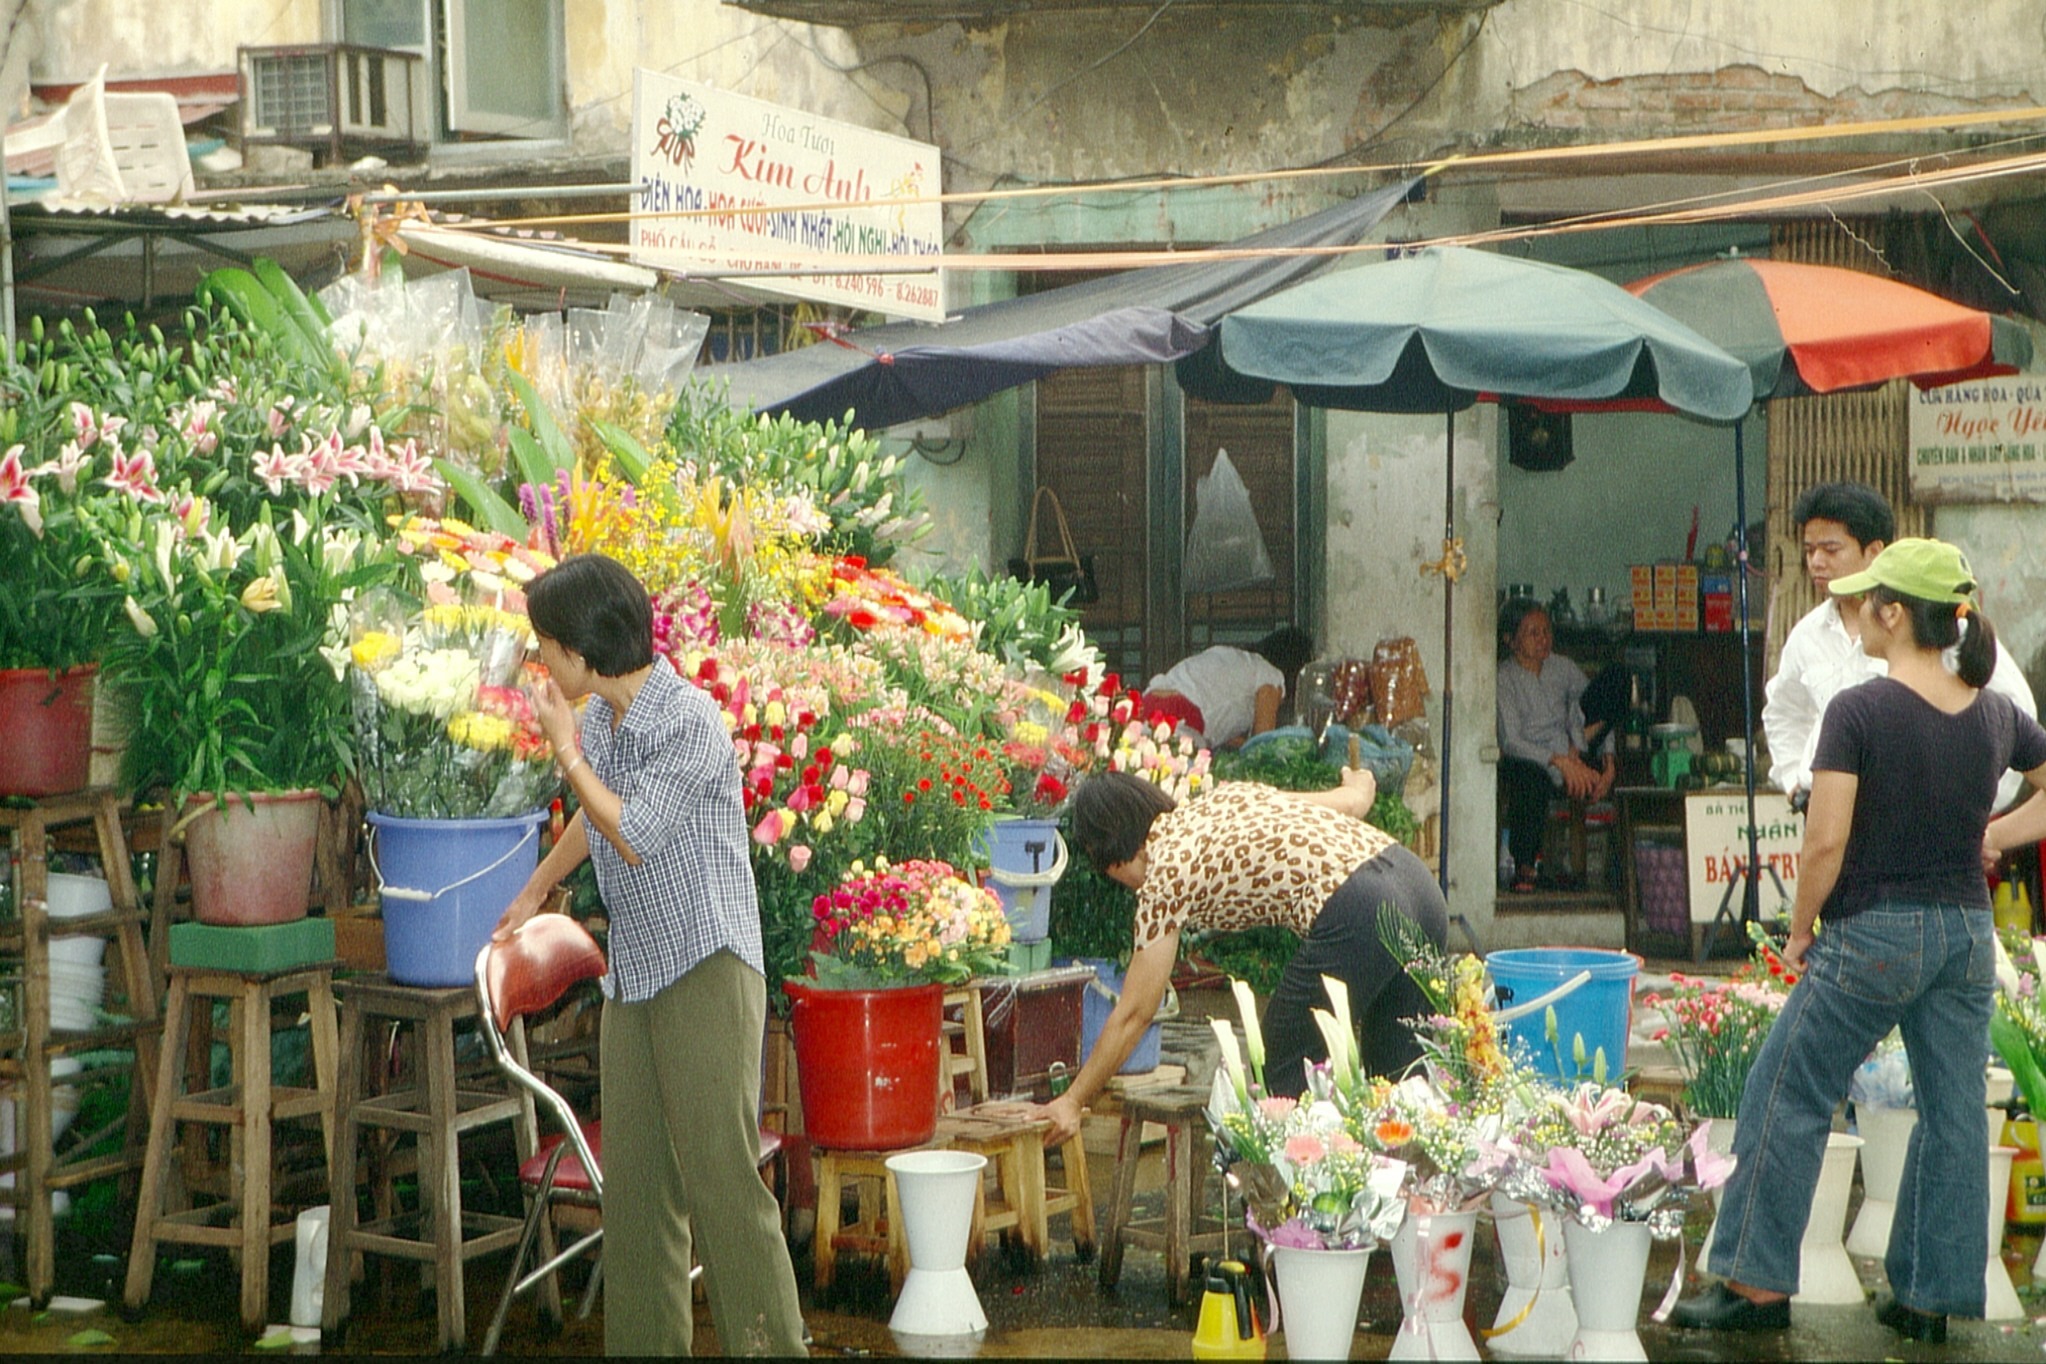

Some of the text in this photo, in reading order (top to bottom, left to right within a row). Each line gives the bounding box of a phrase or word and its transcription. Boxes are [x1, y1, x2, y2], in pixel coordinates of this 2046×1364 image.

[762, 113, 796, 144] Hoa
[718, 133, 872, 203] Kim Anh
